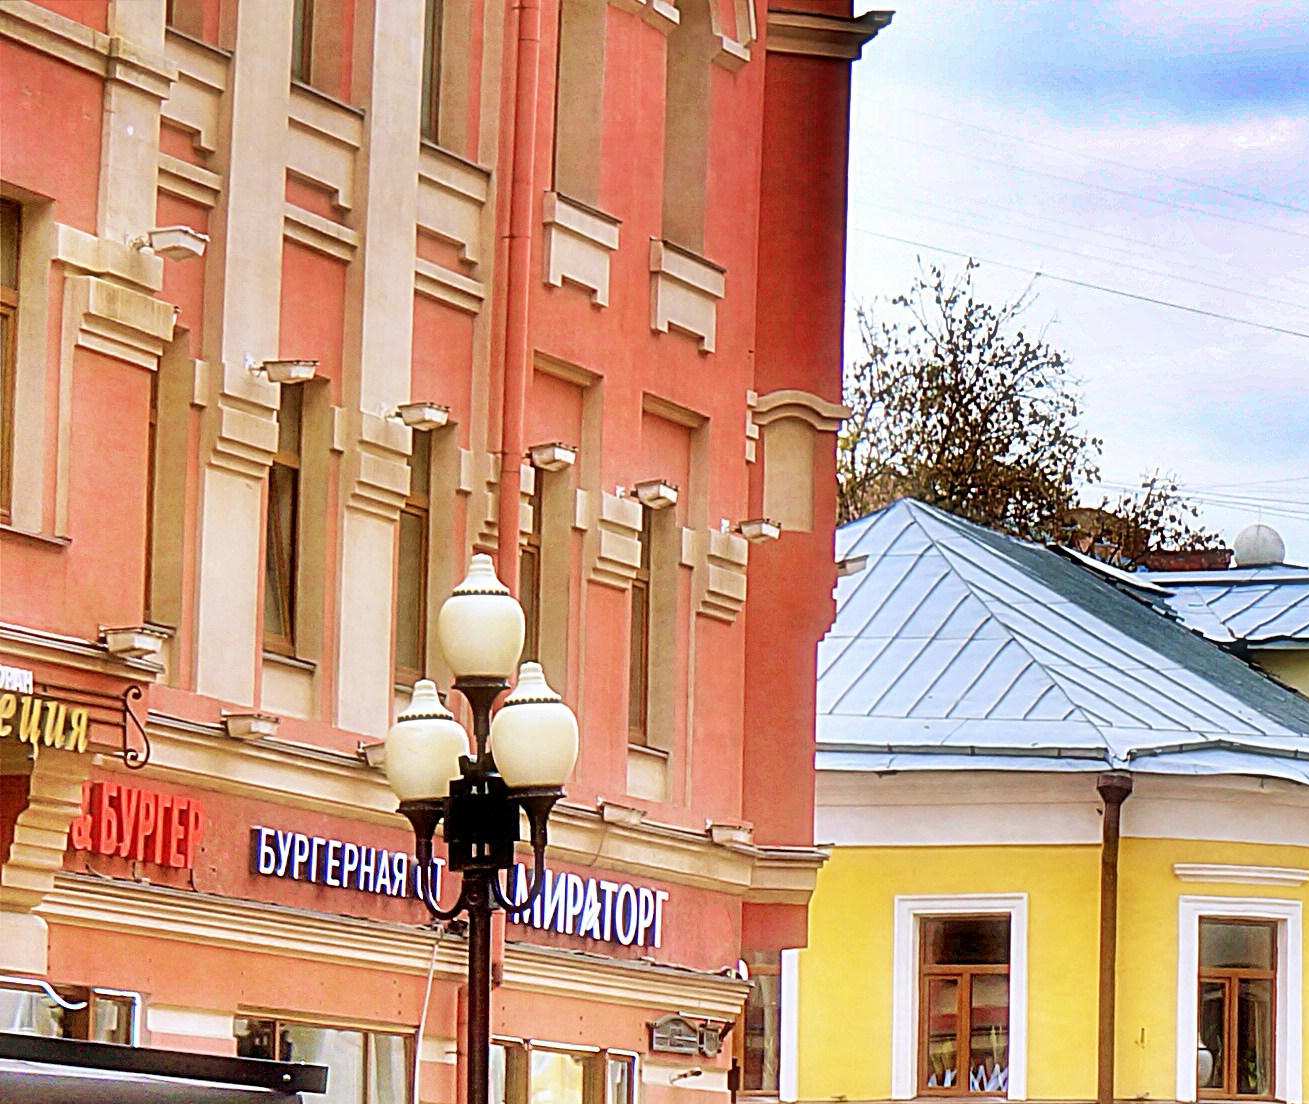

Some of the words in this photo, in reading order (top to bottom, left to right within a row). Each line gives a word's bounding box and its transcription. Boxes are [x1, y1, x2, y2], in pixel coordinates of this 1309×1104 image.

[99, 780, 206, 870] БУРГЕР
[257, 826, 408, 898] БУРГЕРНАЯ
[512, 861, 669, 949] МИРАТОРГ
